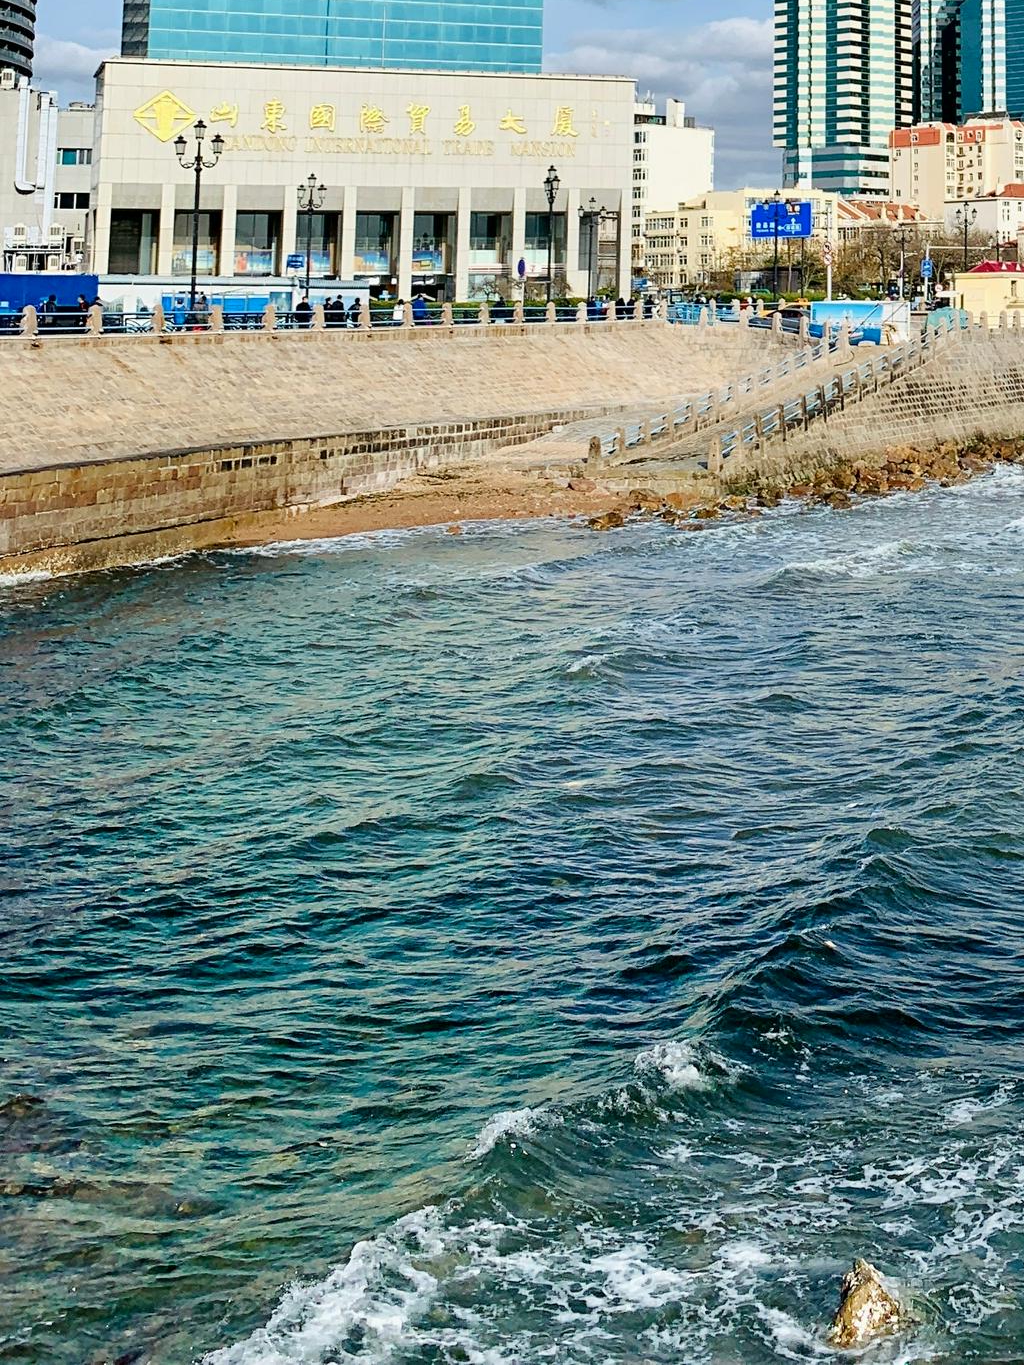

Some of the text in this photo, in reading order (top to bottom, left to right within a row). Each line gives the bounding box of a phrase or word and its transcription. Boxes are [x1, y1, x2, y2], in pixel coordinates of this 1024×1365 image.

[211, 135, 576, 158] HANDONG INTERNATIONAL TRADE MANSION
